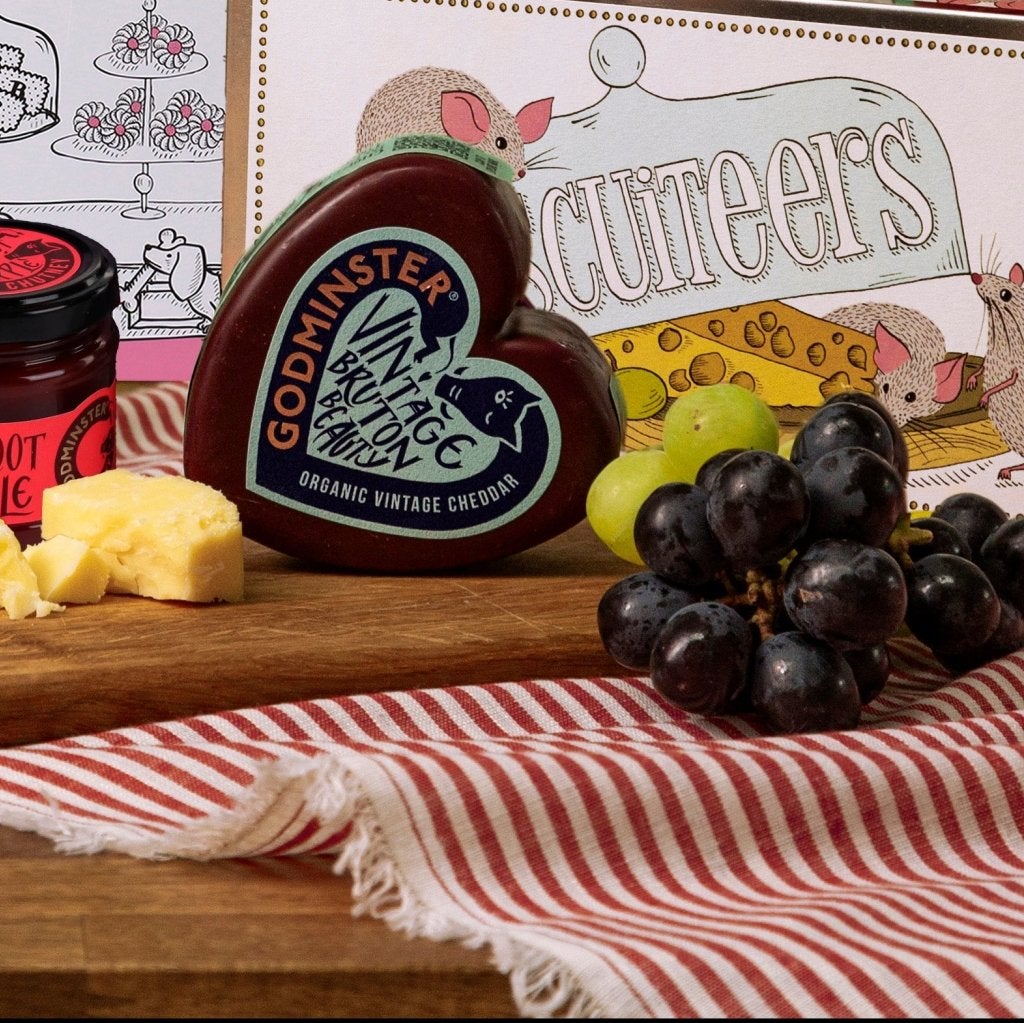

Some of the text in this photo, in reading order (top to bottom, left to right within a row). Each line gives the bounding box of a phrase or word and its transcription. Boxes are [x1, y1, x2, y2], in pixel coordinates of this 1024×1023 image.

[312, 388, 391, 468] BEAUTY
[327, 349, 423, 472] BRUTON
[347, 292, 478, 470] VINTAGE
[299, 470, 520, 513] ORGANIC VINTAGE CHEDDAR
